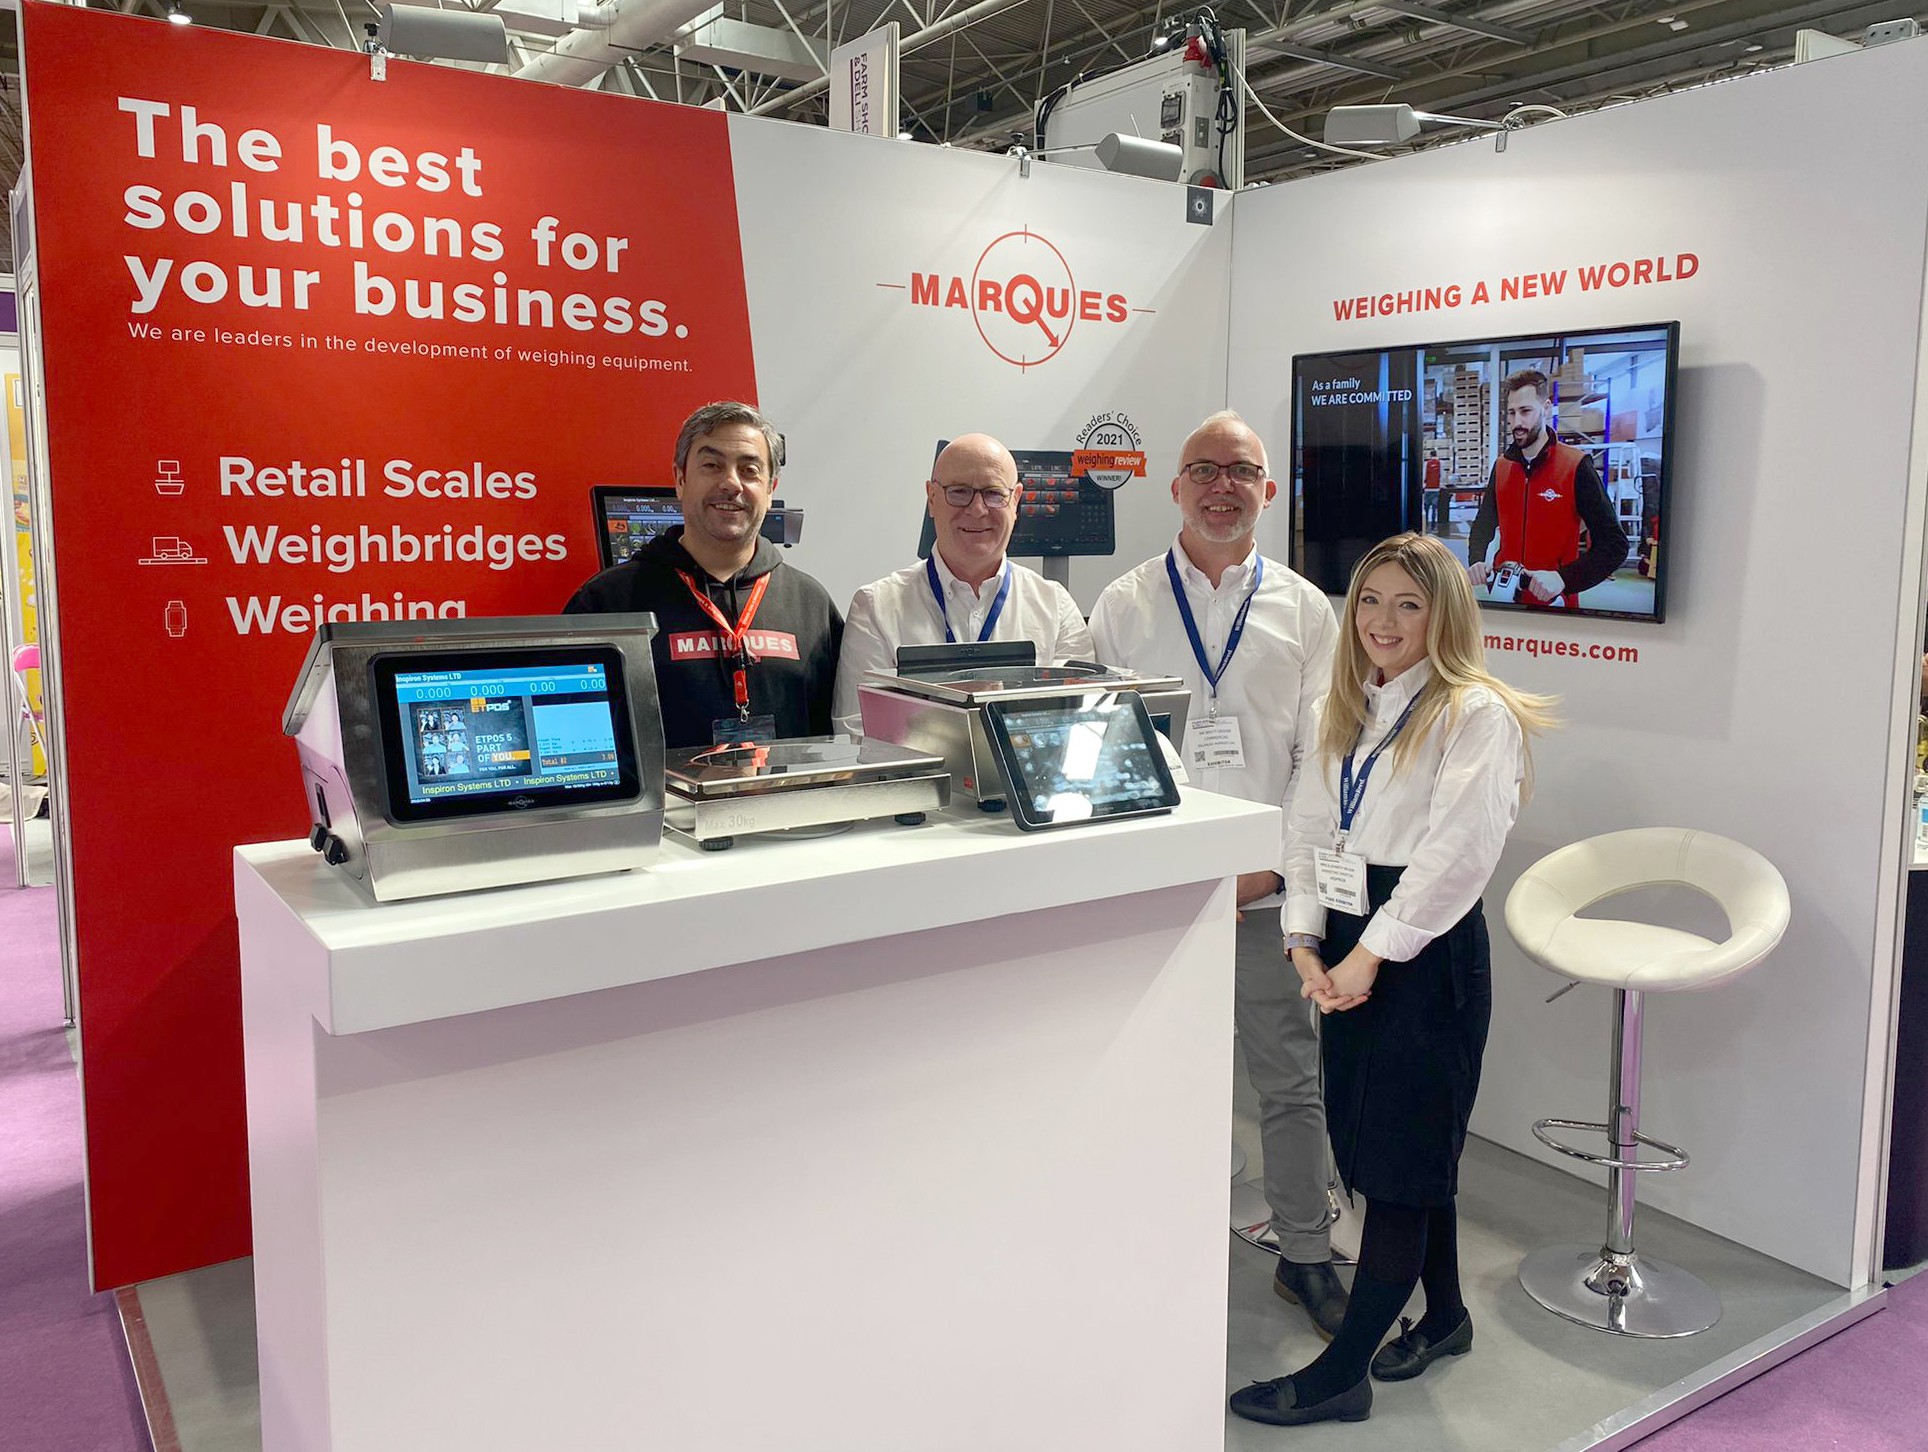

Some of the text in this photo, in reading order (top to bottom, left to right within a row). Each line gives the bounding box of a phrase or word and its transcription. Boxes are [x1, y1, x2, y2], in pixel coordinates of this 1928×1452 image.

[854, 56, 861, 67] &
[860, 52, 868, 99] FARM
[118, 97, 484, 198] The best
[124, 181, 629, 273] solutions for
[124, 256, 689, 339] your business.
[1333, 253, 1699, 321] WEIGHING A NEW WORLD
[911, 272, 1128, 338] MARQUES
[128, 322, 693, 373] We are leaders in the development of weighing equipment.
[1311, 389, 1412, 406] WE ARE COMMITTED
[1312, 377, 1361, 391] As a family
[1096, 433, 1124, 446] 2021
[1116, 412, 1142, 446] Choice
[220, 457, 537, 500] Retail Scales
[1096, 474, 1122, 482] WINNER!
[223, 524, 567, 573] Weighbridges
[677, 634, 793, 653] MARQUES
[1484, 634, 1639, 663] marques.com
[416, 678, 606, 699] 0.000 0.000 0.00 0.00
[422, 673, 448, 683] Systems
[449, 672, 462, 680] LTD
[475, 732, 512, 744] ETPOS 5
[477, 743, 502, 754] PART
[478, 751, 516, 763] OF YOU.
[422, 784, 455, 796] Inspiron
[457, 781, 492, 793] Systems
[494, 778, 511, 788] LTD
[523, 776, 555, 786] Inspiron
[556, 772, 589, 784] Systems
[591, 769, 607, 780] LTD
